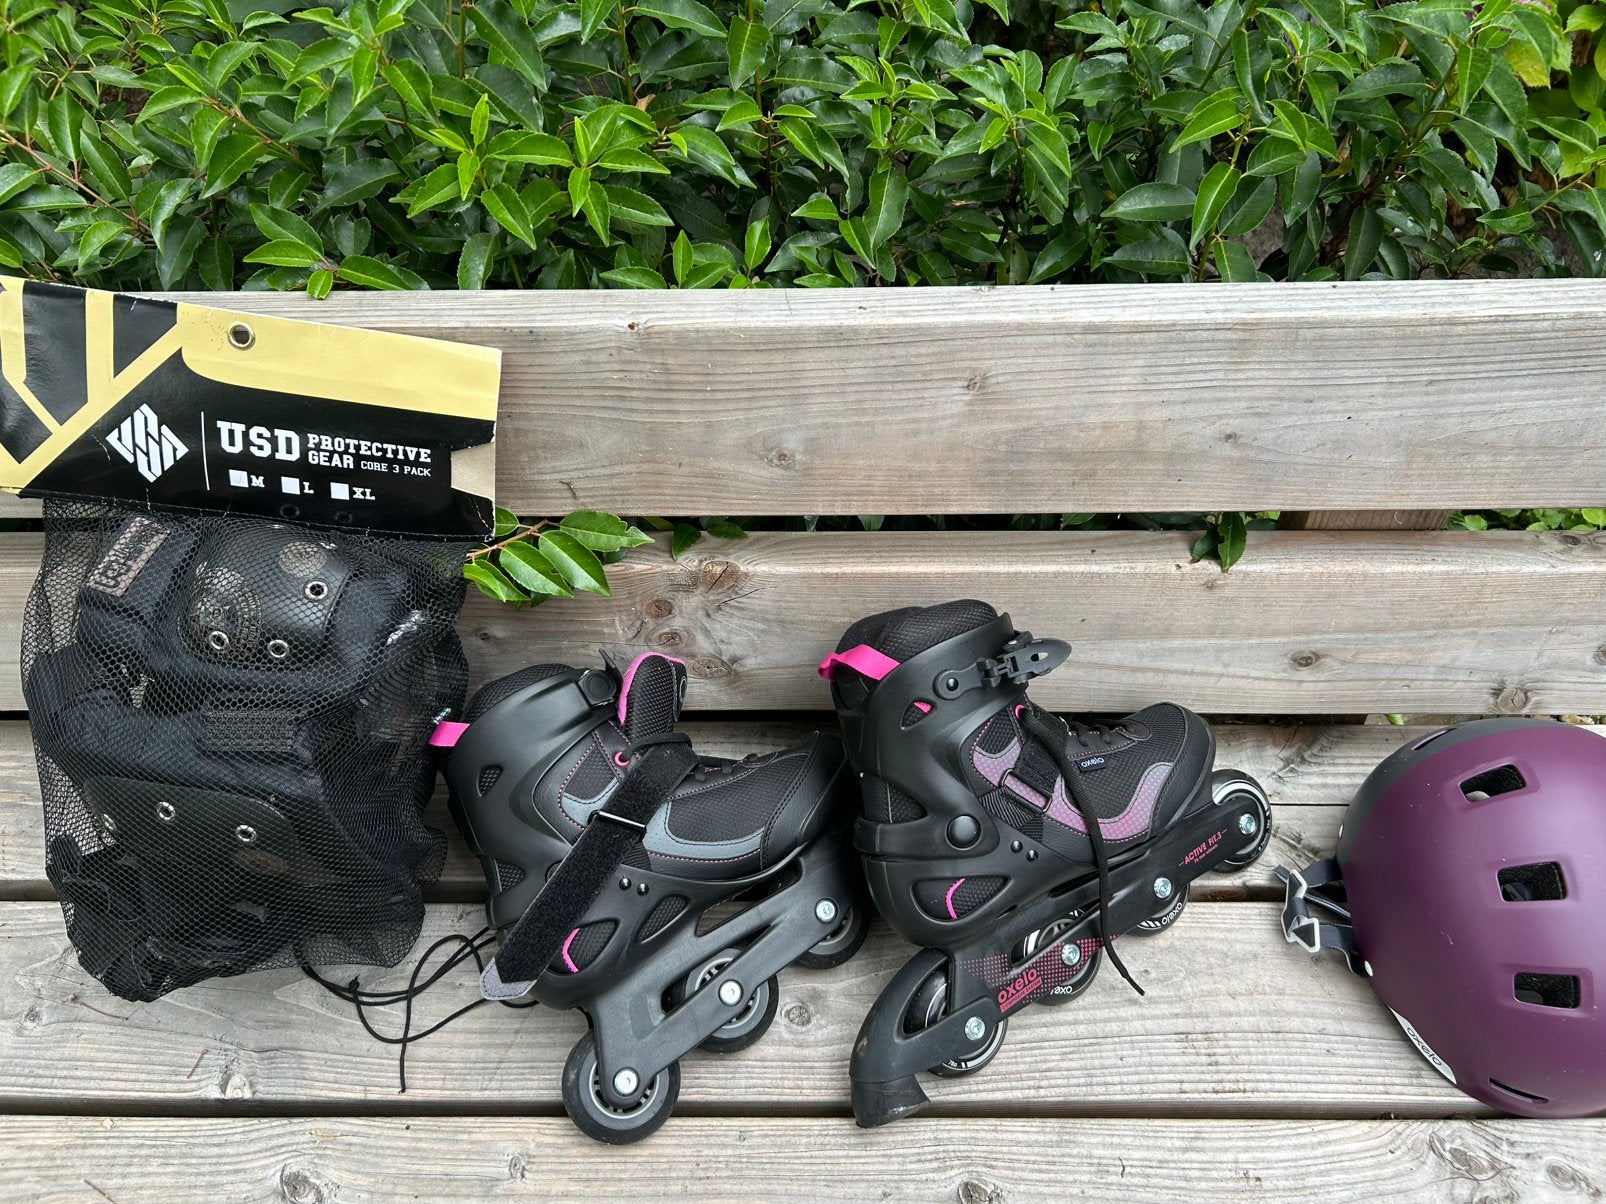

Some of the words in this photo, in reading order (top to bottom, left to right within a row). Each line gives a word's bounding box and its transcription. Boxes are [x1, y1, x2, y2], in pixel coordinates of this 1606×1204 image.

[217, 421, 300, 461] USD
[307, 433, 431, 462] PROTECTIVE
[308, 450, 354, 469] GEAR
[361, 461, 388, 472] CORE
[393, 465, 399, 473] 3
[404, 466, 431, 476] PACK
[250, 475, 265, 488] M
[303, 482, 314, 494] L
[353, 487, 375, 500] XL
[1081, 757, 1104, 767] oxelo
[1185, 843, 1207, 864] ACTIVE
[1162, 902, 1183, 925] oxelo
[998, 968, 1037, 1003] oxelo
[1407, 1027, 1441, 1066] oxelo
